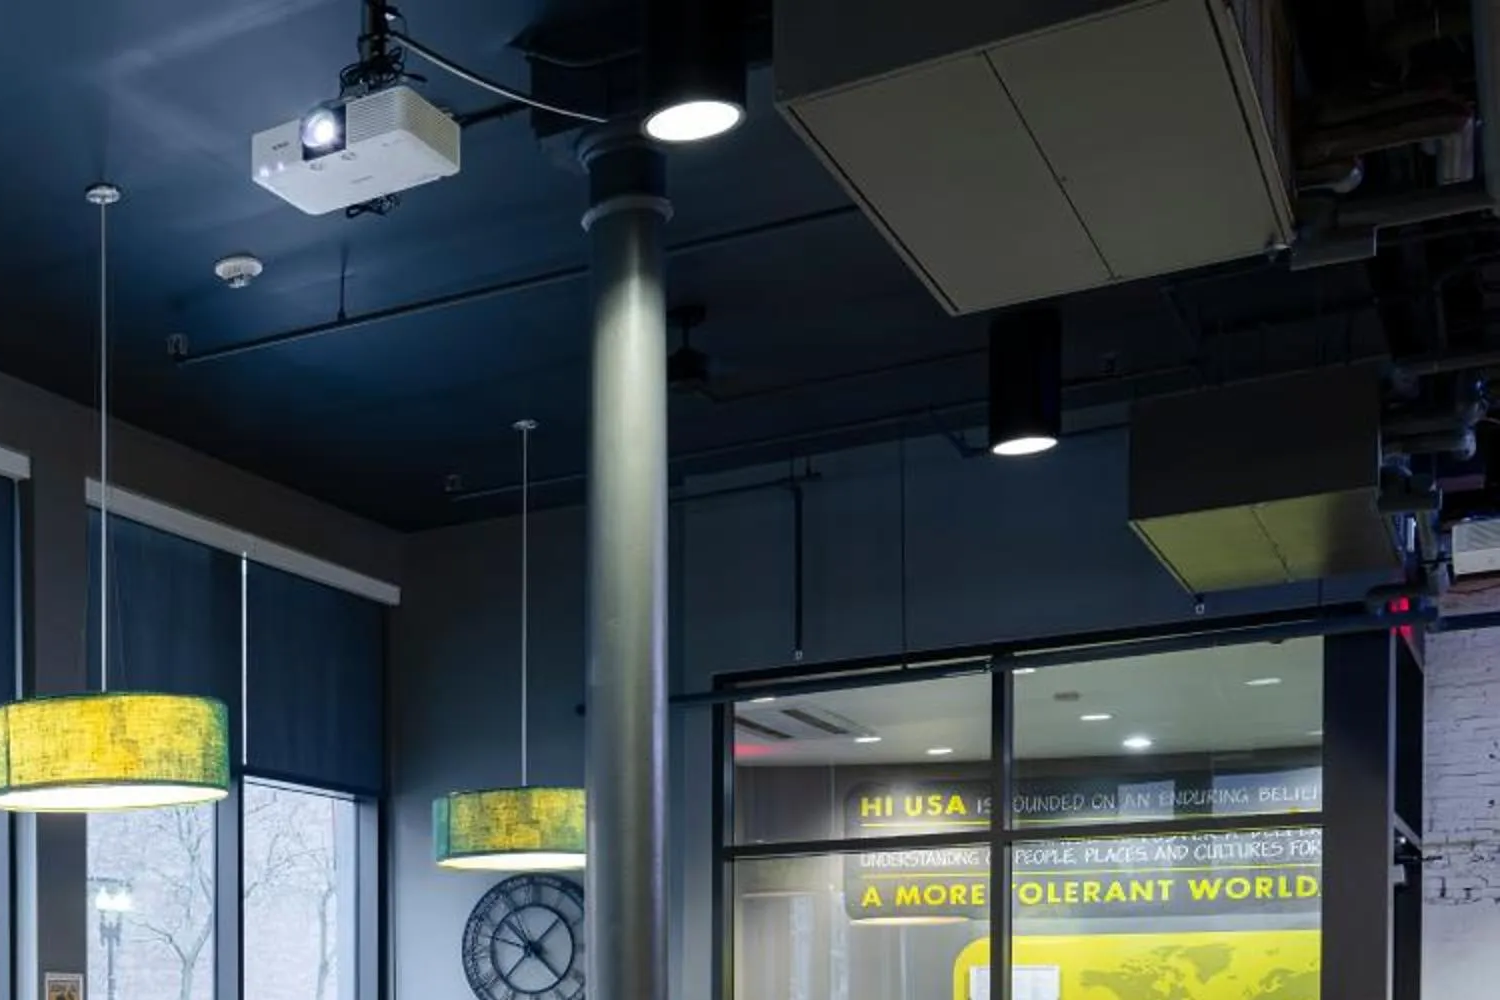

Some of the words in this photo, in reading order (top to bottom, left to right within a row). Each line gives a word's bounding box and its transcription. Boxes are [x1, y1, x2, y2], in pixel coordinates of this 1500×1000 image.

[861, 796, 893, 818] HI
[904, 795, 967, 816] USA
[1012, 795, 1084, 814] OUNDED
[1092, 793, 1114, 809] ON
[1124, 791, 1151, 807] AN
[1158, 786, 1249, 807] ENDURING
[860, 849, 981, 868] UNDERSTANDING
[1154, 845, 1189, 861] AND
[1194, 843, 1284, 859] CULTURES
[1291, 839, 1322, 856] FOR
[861, 885, 882, 907] A
[896, 884, 986, 906] MORE
[1012, 879, 1175, 905] OLERANT
